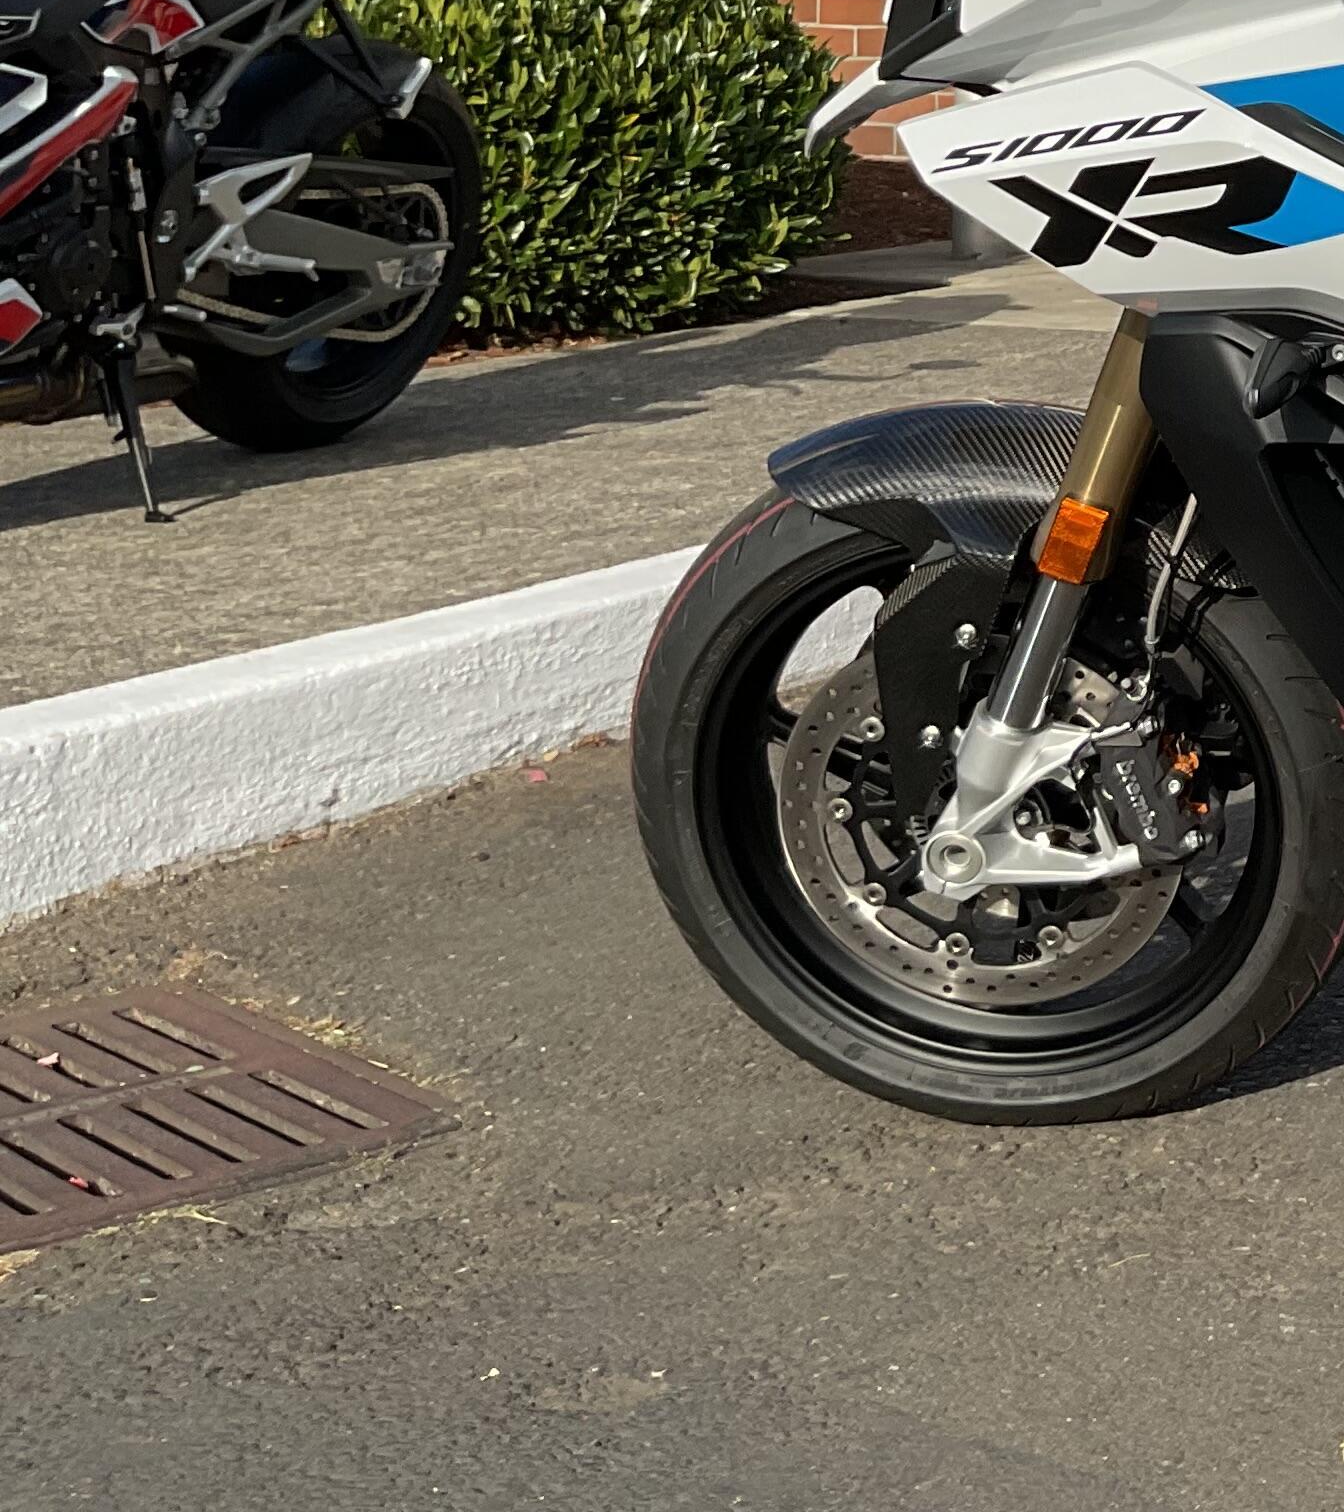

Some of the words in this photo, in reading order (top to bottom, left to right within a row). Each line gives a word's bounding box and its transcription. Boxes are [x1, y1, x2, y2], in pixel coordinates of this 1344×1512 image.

[931, 108, 1207, 175] S1000
[988, 154, 1302, 268] XR
[1115, 759, 1160, 841] brembo
